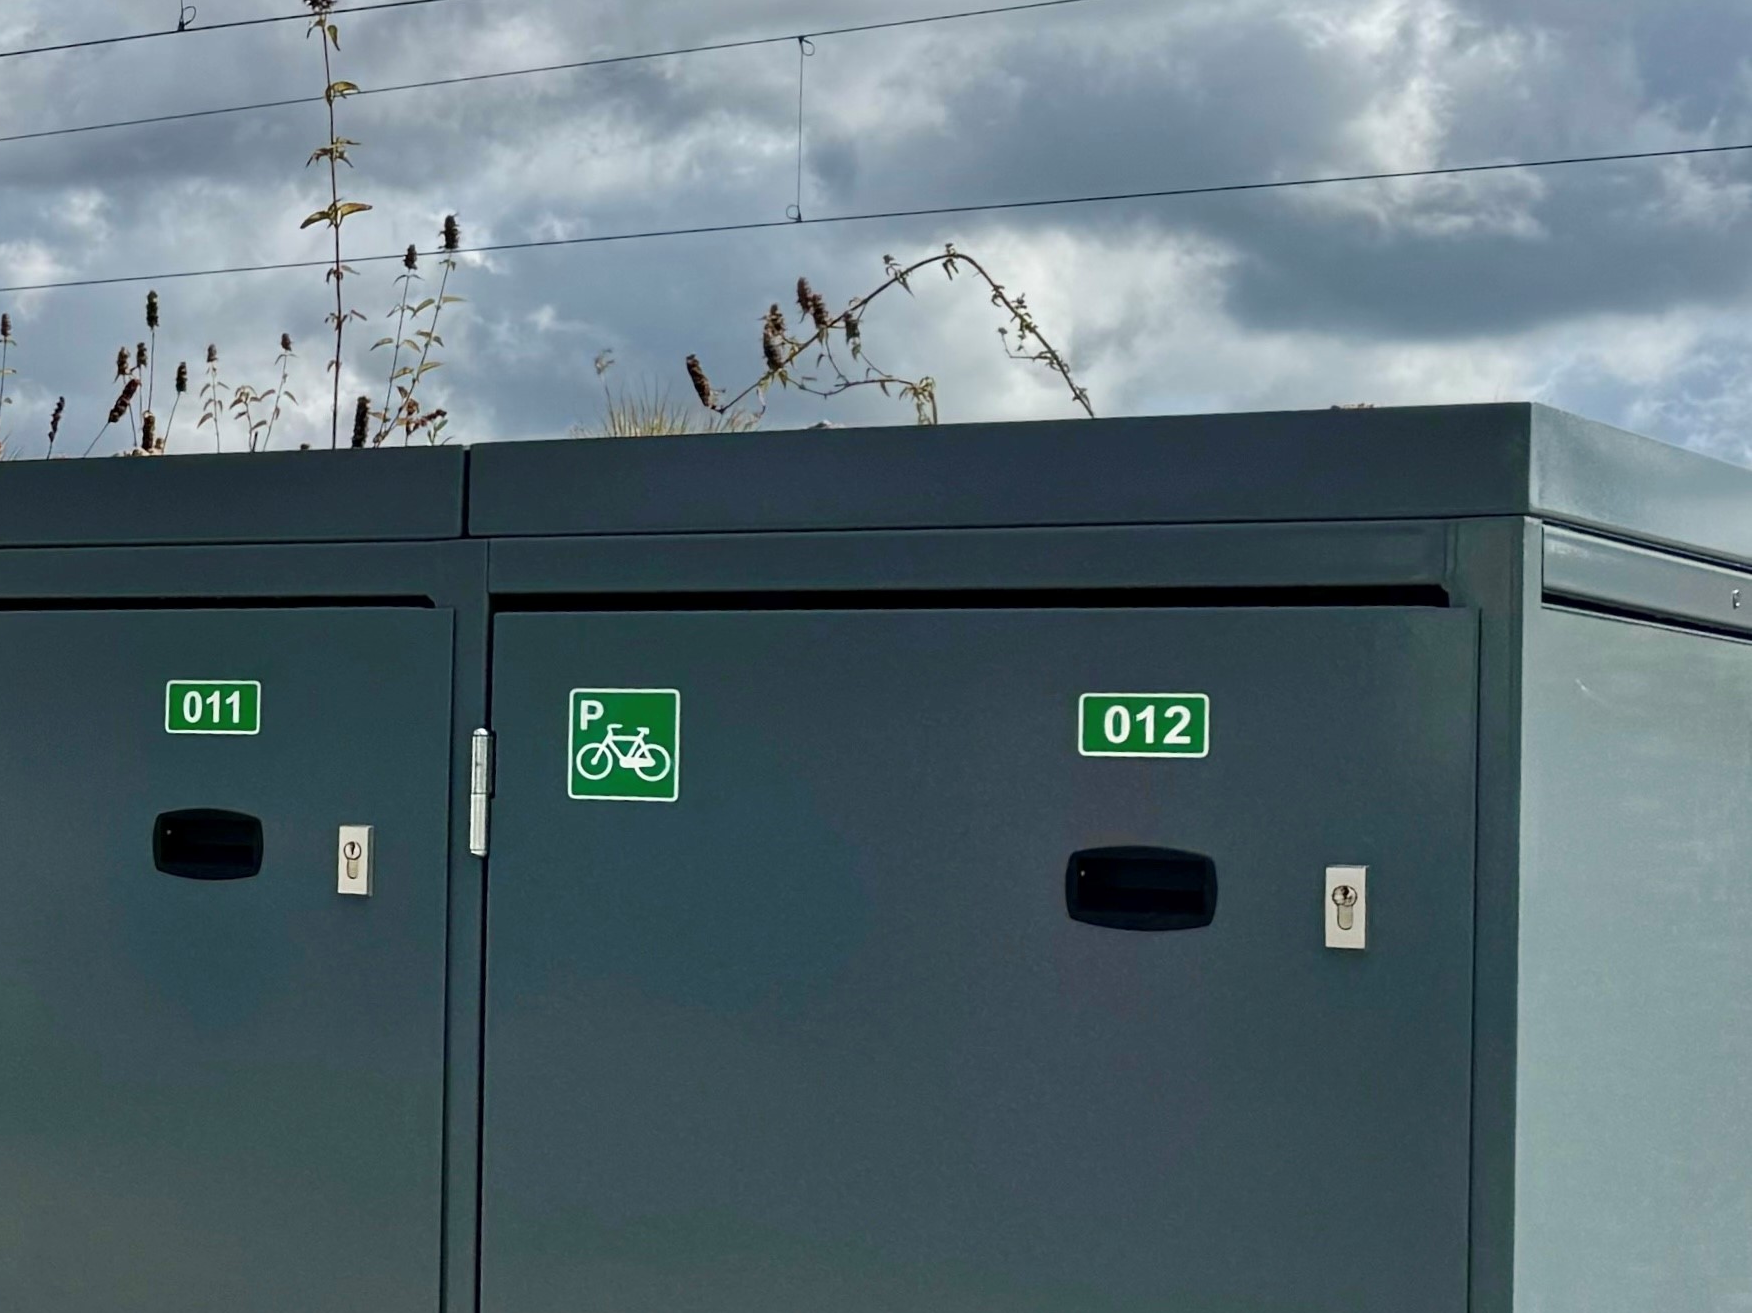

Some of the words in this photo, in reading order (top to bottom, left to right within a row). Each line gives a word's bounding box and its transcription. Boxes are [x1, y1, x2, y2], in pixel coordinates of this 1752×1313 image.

[183, 691, 240, 723] 011
[580, 700, 604, 730] P
[1104, 705, 1191, 744] 012
